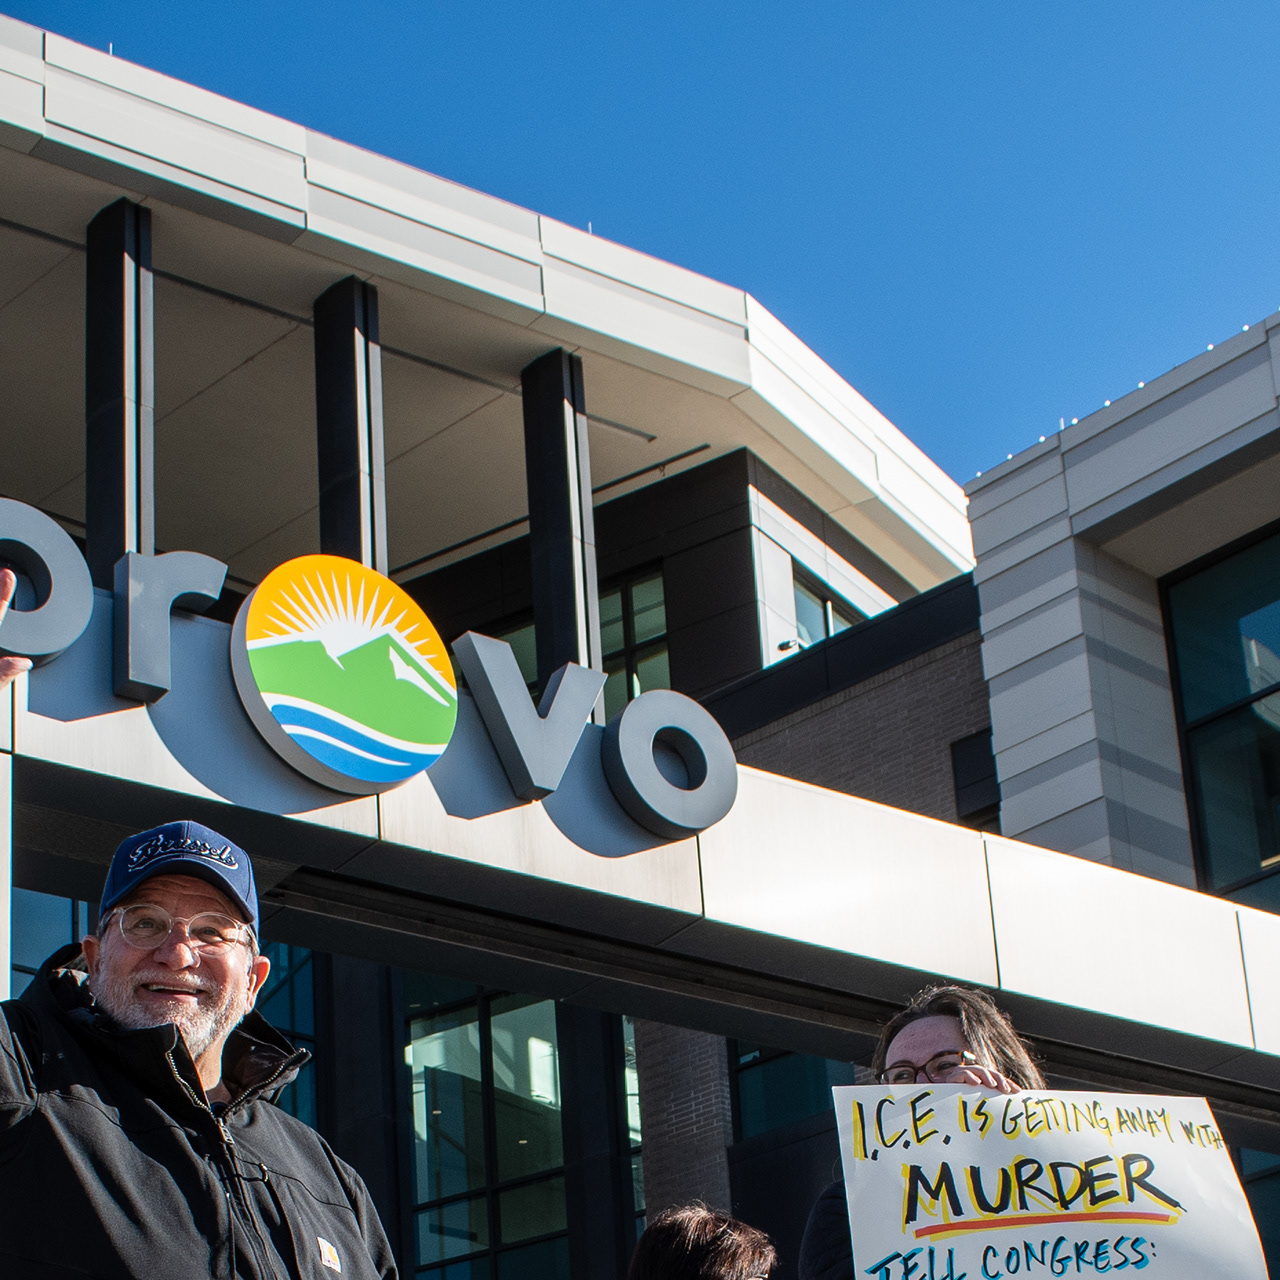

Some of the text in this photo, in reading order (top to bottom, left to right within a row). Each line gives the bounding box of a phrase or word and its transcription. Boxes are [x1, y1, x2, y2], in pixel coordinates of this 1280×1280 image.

[959, 1096, 995, 1140] IS
[1001, 1096, 1114, 1146] GETTING
[1116, 1106, 1175, 1143] AWAY
[1179, 1119, 1224, 1150] WITH
[901, 1153, 1187, 1224] MURDER
